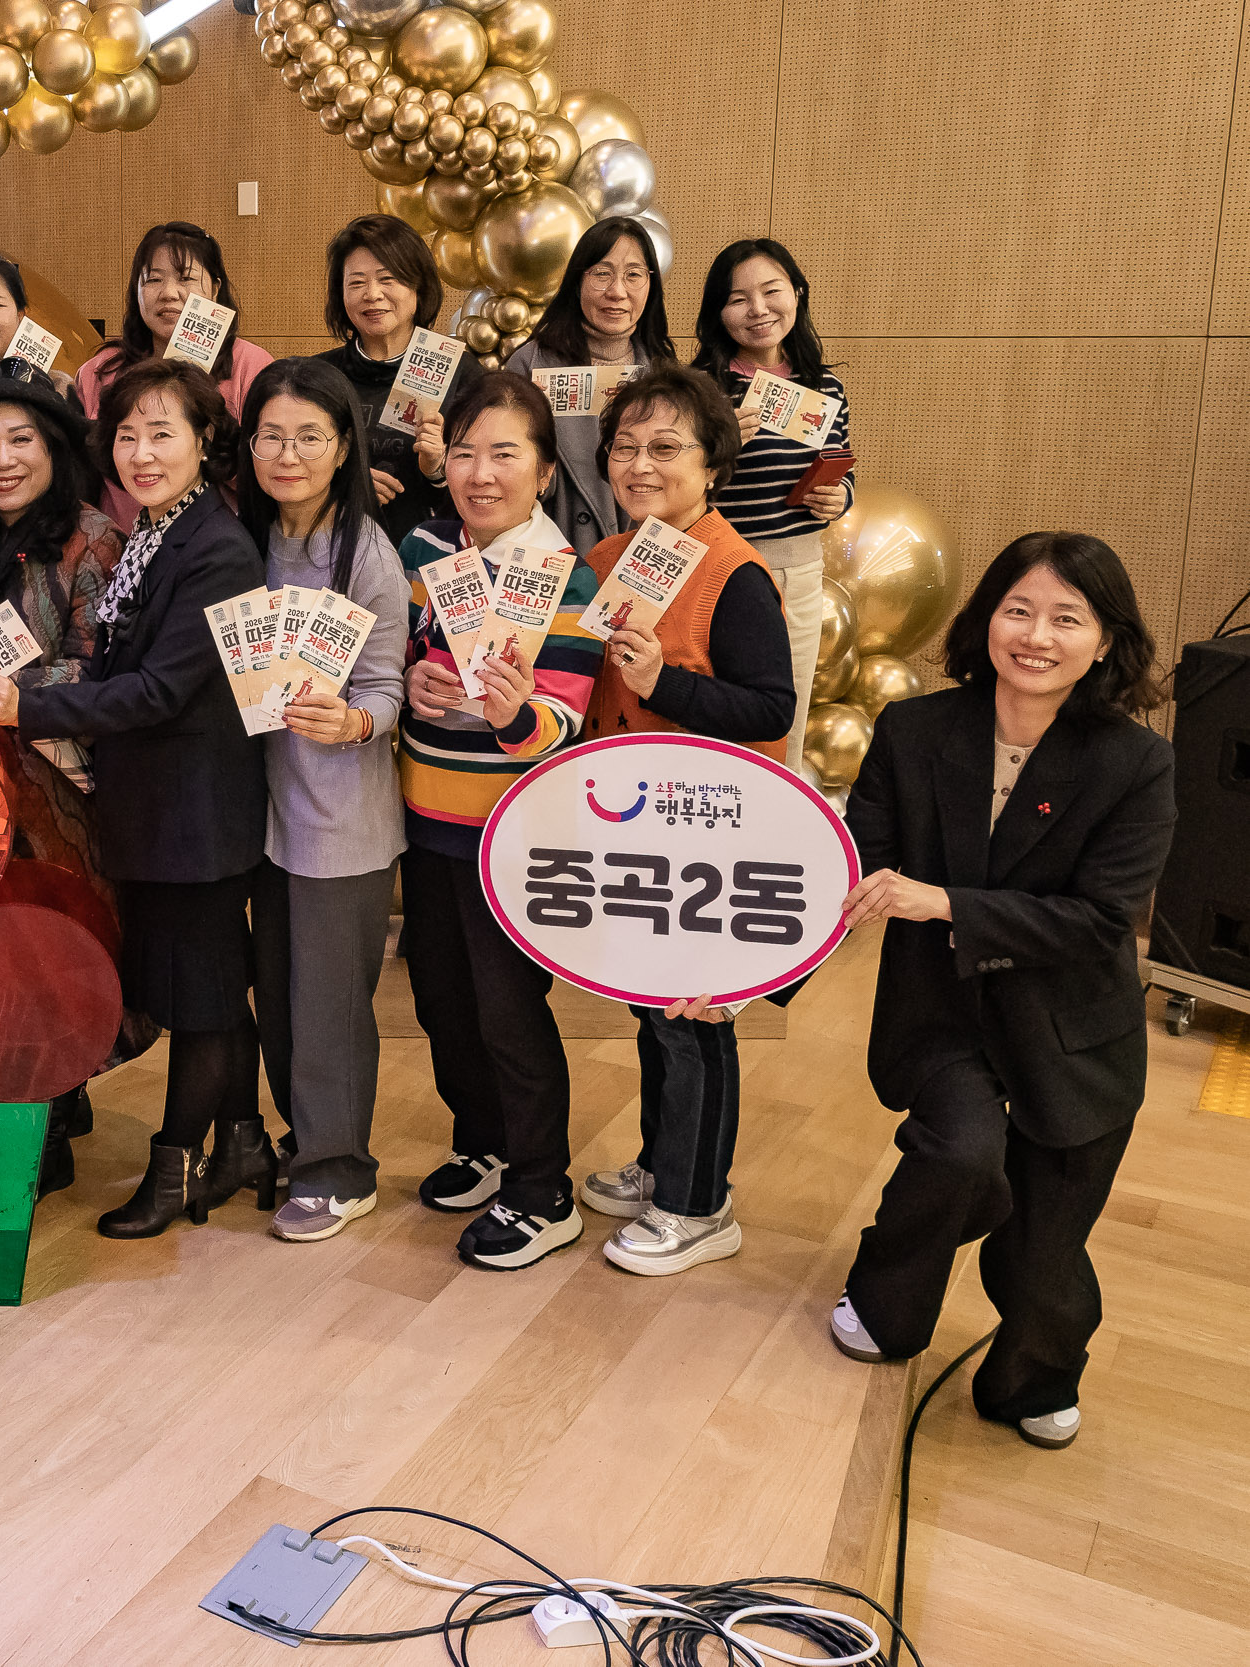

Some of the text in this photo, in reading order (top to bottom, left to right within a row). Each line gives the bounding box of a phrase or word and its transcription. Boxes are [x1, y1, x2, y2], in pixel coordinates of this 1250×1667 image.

[179, 329, 215, 350] 겨울나기
[182, 318, 220, 341] 따뜻한
[16, 339, 48, 366] 따뜻한
[409, 353, 450, 375] 따뜻한
[406, 365, 444, 384] 겨울나기
[556, 374, 570, 412] 따뜻한
[569, 374, 578, 411] 겨울나기
[760, 384, 783, 422] 따뜻한
[770, 387, 790, 426] 겨울나기
[641, 538, 659, 552] 2026
[508, 566, 528, 576] 2026
[626, 558, 674, 589] 겨울나기
[632, 544, 682, 580] 따뜻한
[435, 584, 451, 594] 2026
[437, 580, 484, 608] 따뜻한
[502, 574, 556, 599] 따뜻한
[443, 596, 489, 620] 겨울나기
[500, 589, 551, 610] 겨울나기
[244, 618, 263, 628] 2026
[288, 608, 304, 618] 2026
[318, 611, 334, 623] 2026
[246, 623, 276, 644] 따뜻
[310, 618, 356, 652] 따뜻한
[304, 632, 350, 663] 겨울나기
[655, 781, 742, 801] 소통하며 발전하는
[655, 799, 742, 829] 행복광진
[525, 847, 807, 945] 중곡2동
